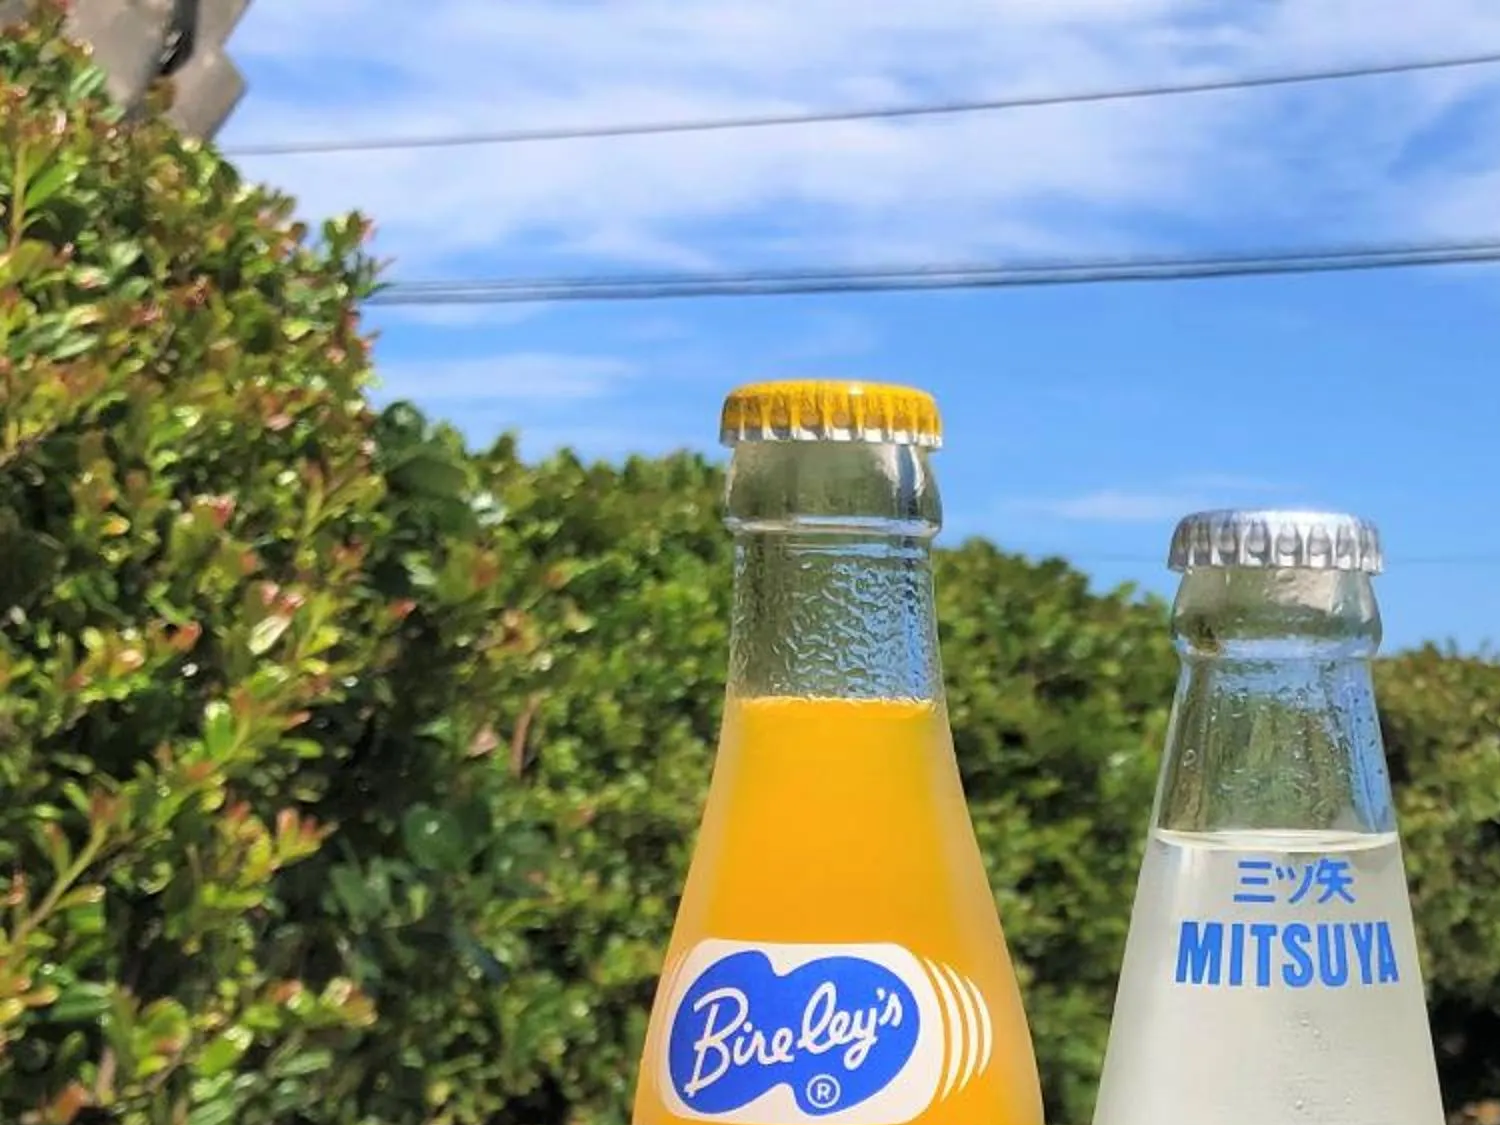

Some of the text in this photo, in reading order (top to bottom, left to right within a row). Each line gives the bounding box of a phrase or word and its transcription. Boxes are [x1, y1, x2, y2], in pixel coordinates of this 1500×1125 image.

[1234, 858, 1355, 904] 三ツ矢
[1175, 921, 1399, 987] MITSUYA
[683, 981, 903, 1098] Bireley's
